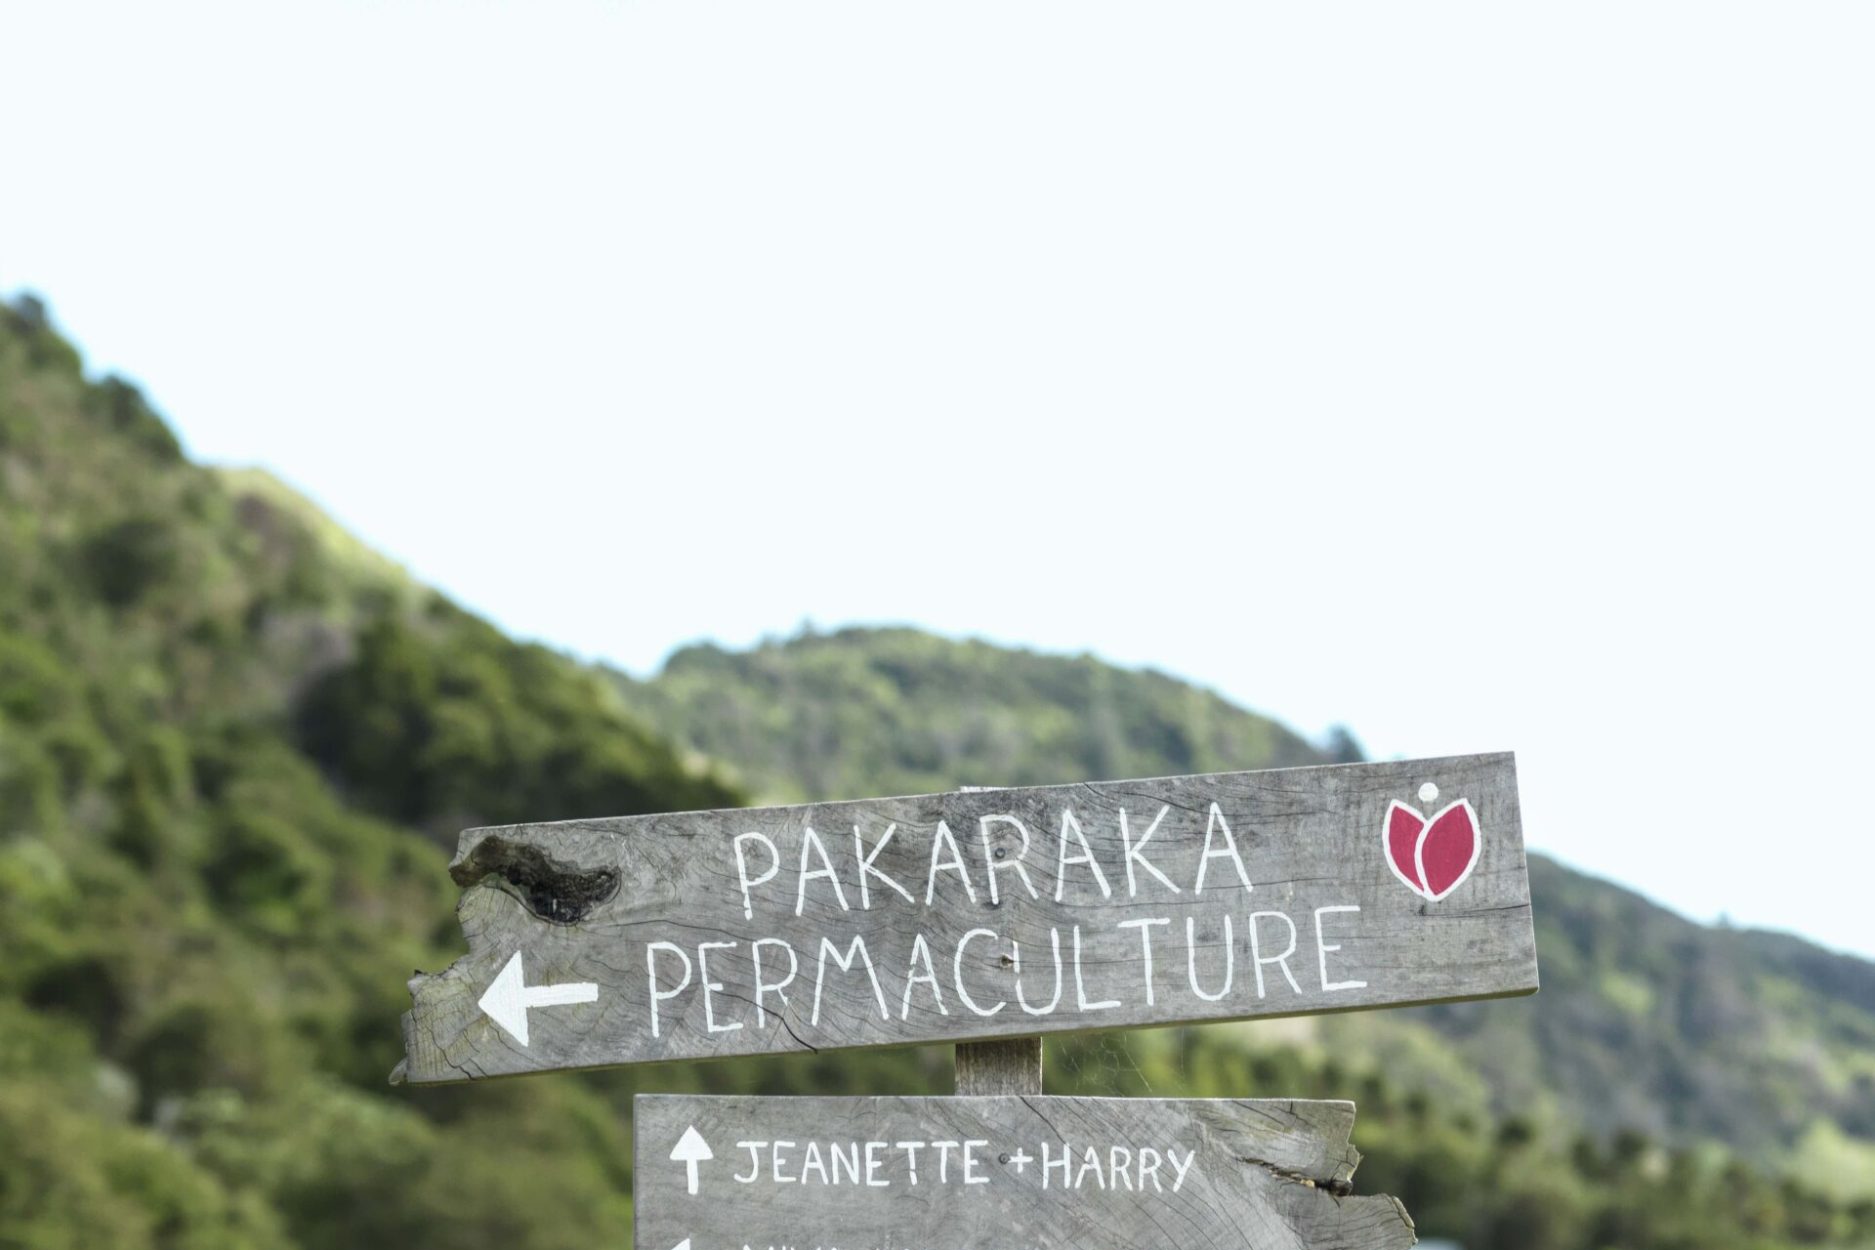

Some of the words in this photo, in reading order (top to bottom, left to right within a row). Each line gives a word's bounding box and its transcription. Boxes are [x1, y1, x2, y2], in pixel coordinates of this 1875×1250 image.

[734, 801, 1254, 920] PAKARAKA
[647, 905, 1368, 1038] PERMACULTURE
[734, 1139, 990, 1187] JEANETTE
